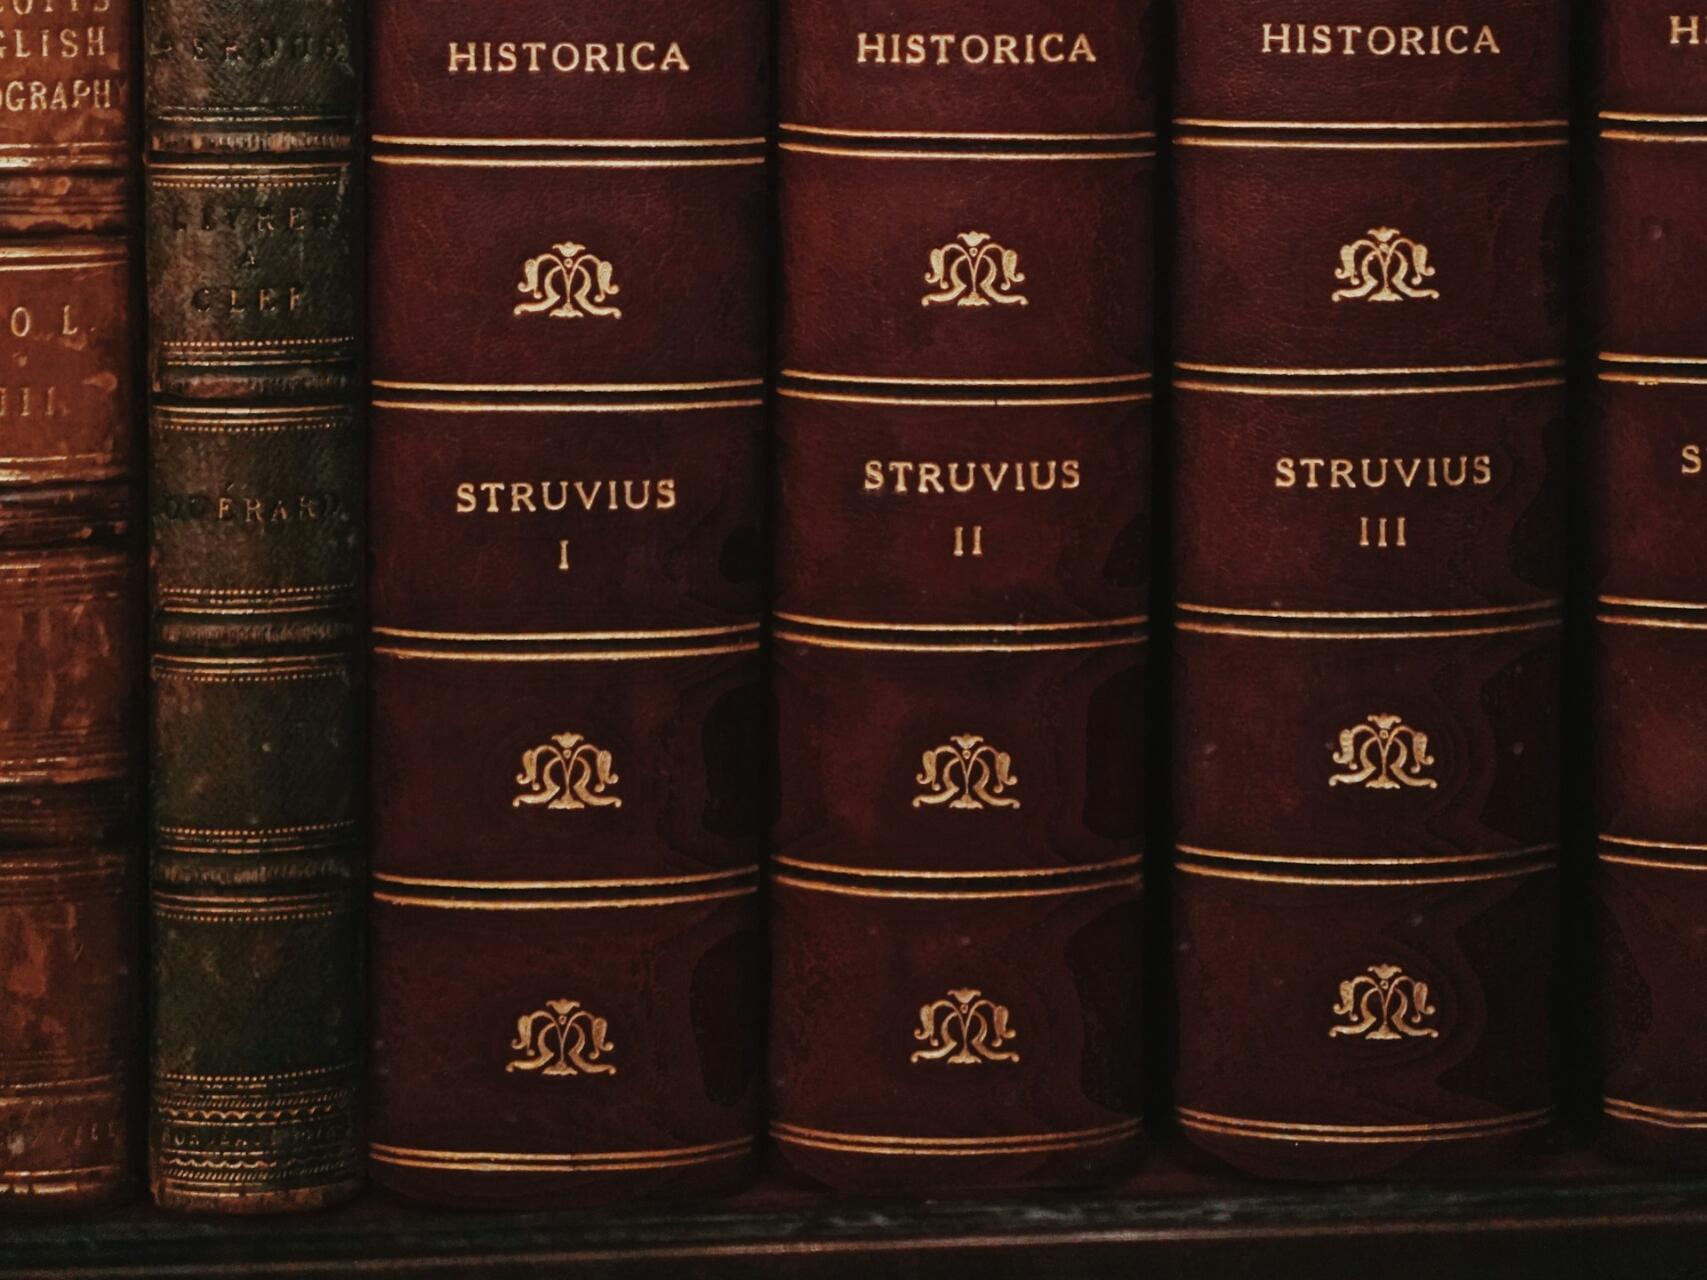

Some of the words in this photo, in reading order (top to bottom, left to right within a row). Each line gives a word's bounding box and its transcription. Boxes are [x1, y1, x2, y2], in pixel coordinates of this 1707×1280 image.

[1261, 23, 1501, 56] HISTORICA
[1669, 15, 1707, 45] H
[447, 41, 690, 74] HISTORICA
[856, 32, 1097, 66] HISTORICA
[864, 460, 1080, 494] STRUVIUS
[1274, 455, 1491, 489] STRUVIUS
[456, 479, 676, 513] STRUVIUS
[953, 525, 983, 557] II
[1359, 516, 1407, 549] III
[558, 539, 570, 570] I
